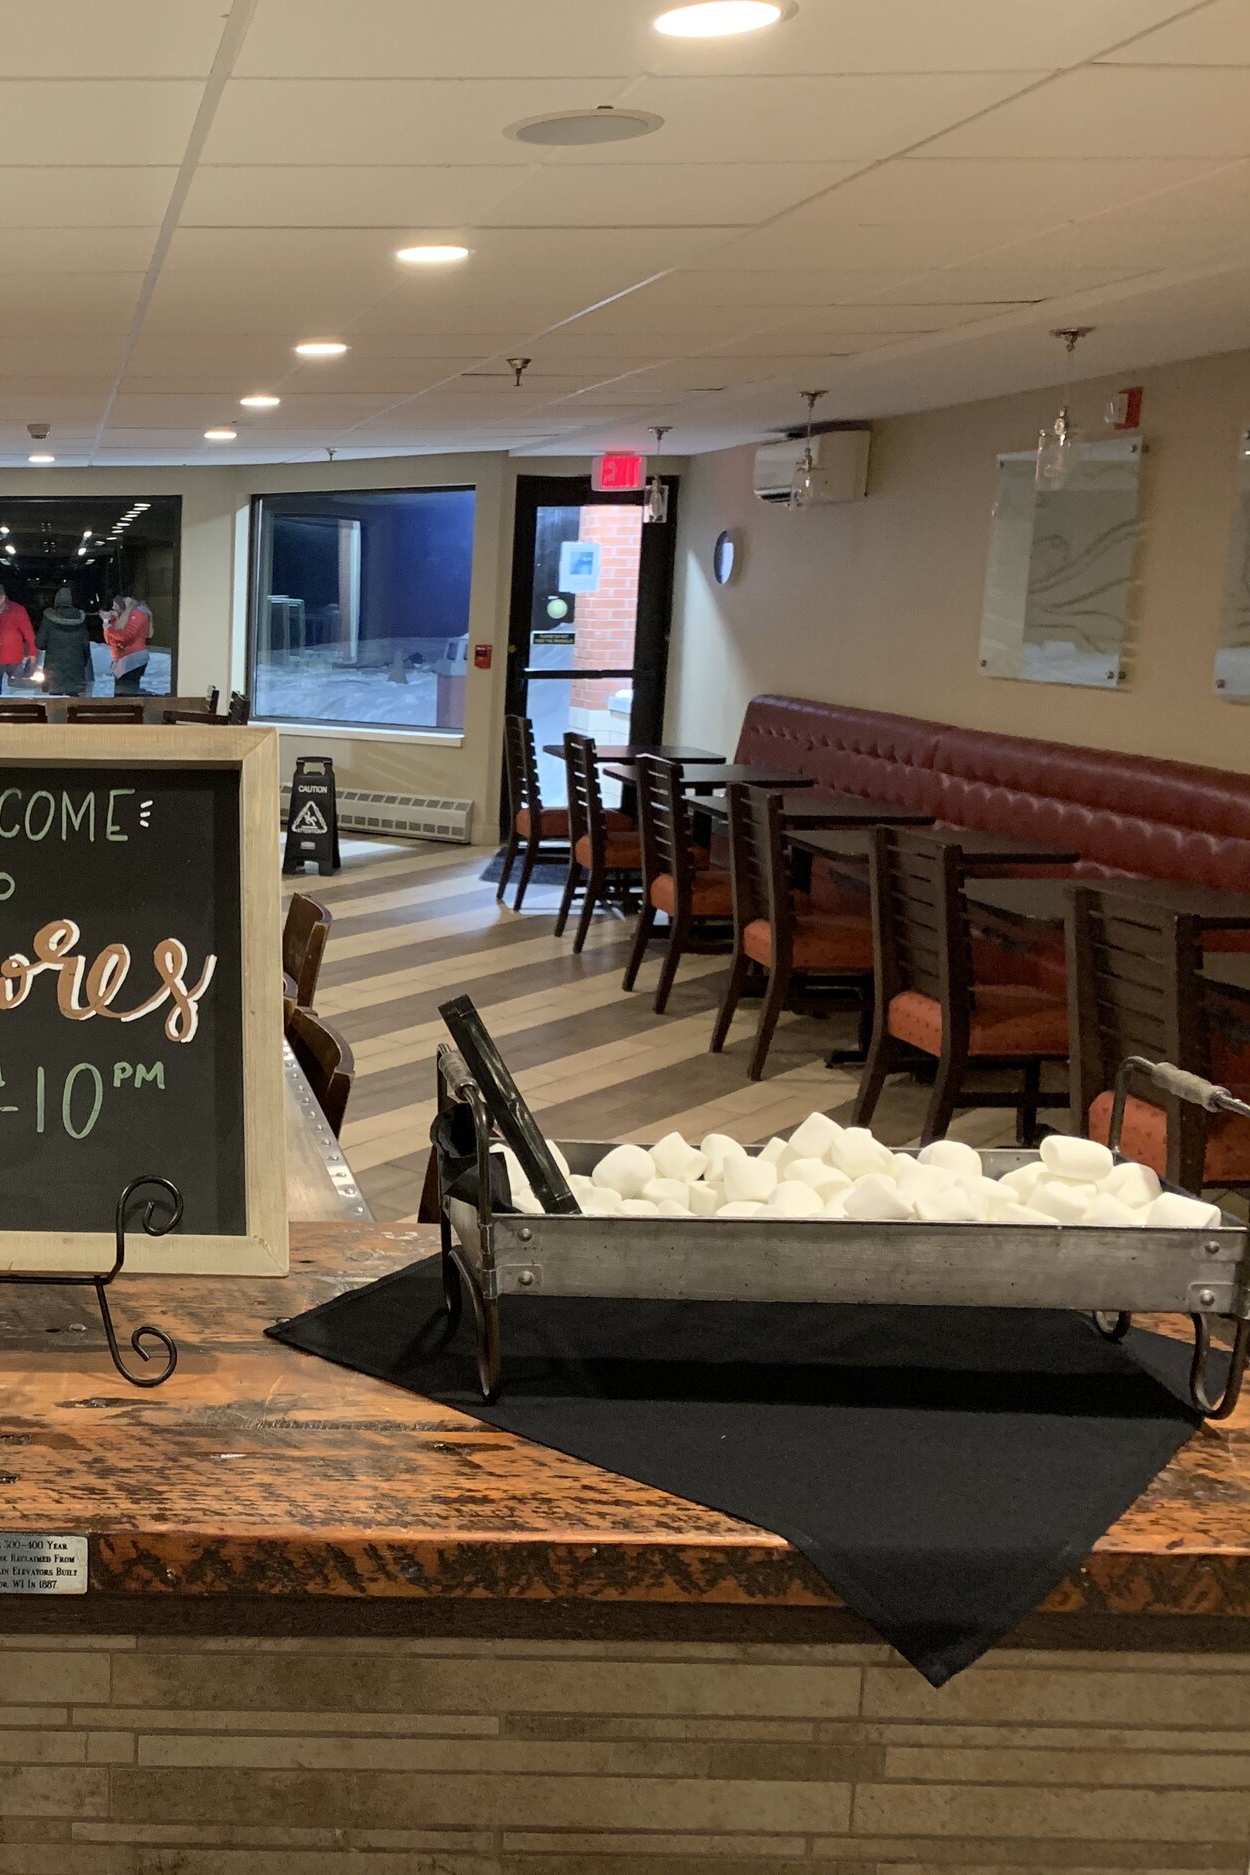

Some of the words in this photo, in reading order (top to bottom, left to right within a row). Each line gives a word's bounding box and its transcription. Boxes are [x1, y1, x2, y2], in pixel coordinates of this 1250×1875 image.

[298, 785, 328, 794] CAUTION
[47, 1541, 68, 1550] YEAR
[11, 1554, 52, 1563] RECLAIMED
[54, 1554, 75, 1563] FROM
[12, 1567, 54, 1576] ELEVATORS
[56, 1567, 78, 1576] BUILT
[12, 1580, 24, 1589] WI
[28, 1580, 36, 1589] IN
